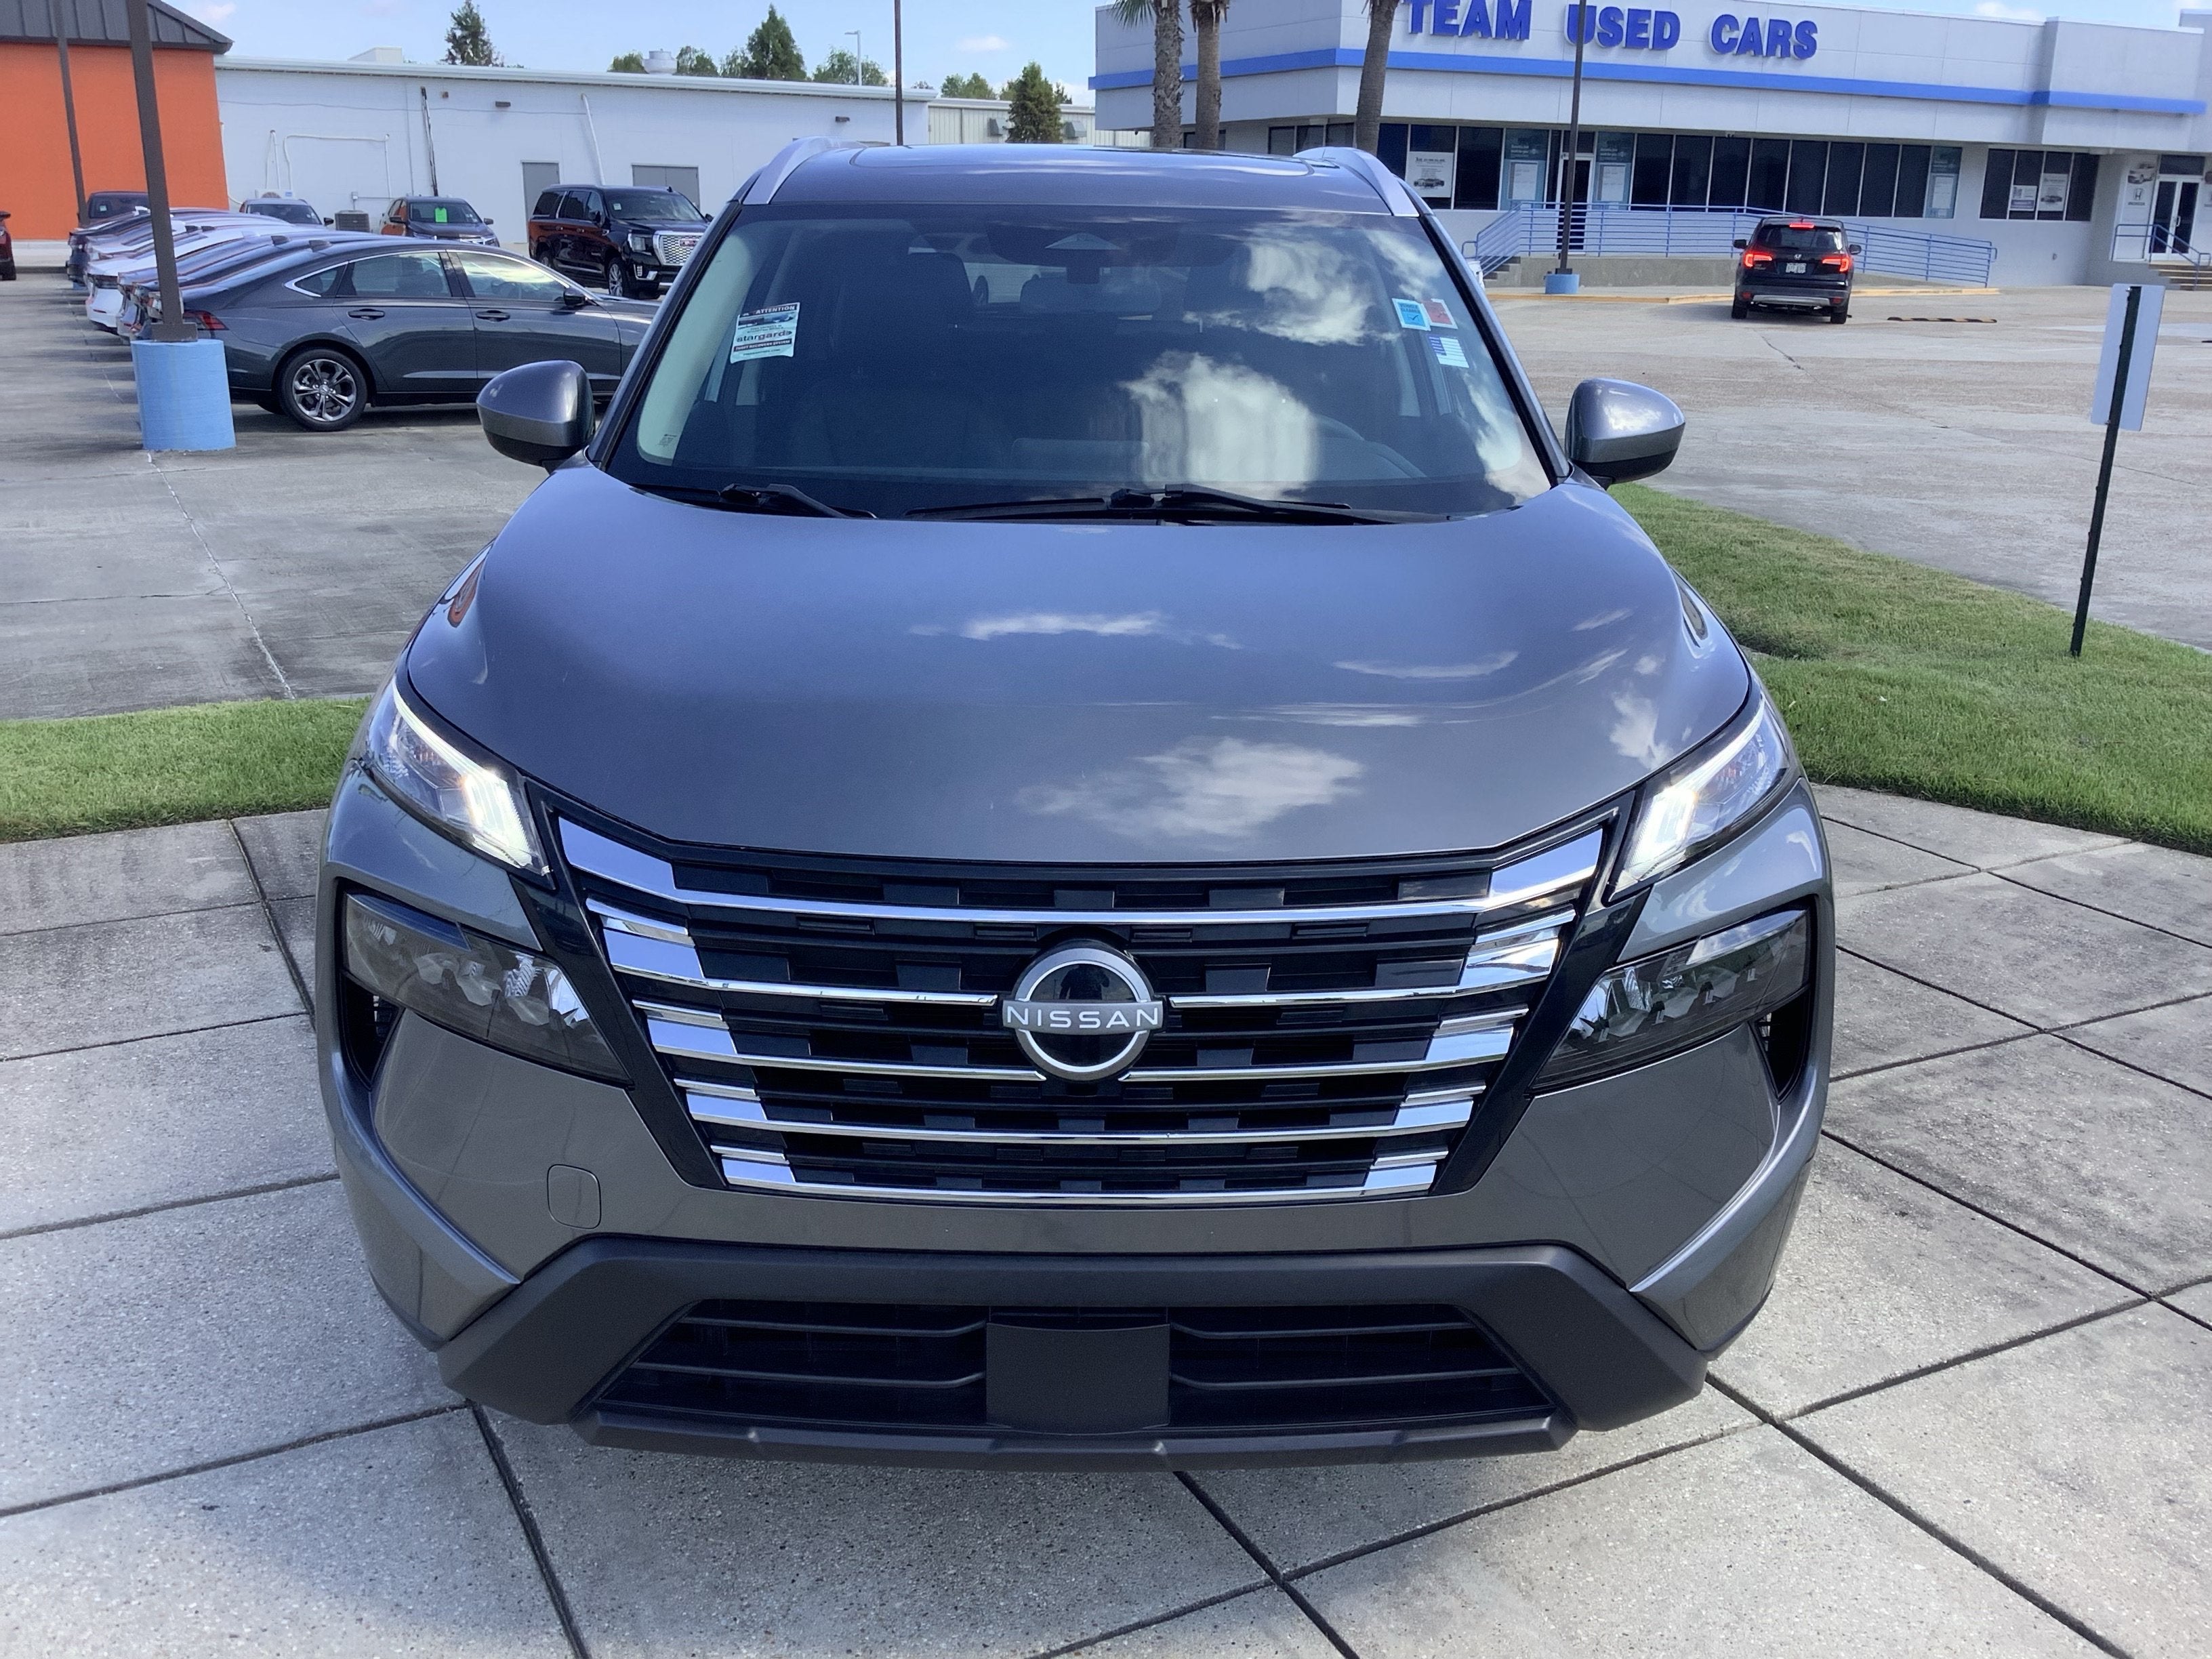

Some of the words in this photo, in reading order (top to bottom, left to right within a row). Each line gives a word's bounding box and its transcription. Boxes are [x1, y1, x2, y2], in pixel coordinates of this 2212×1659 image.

[1402, 0, 1532, 40] TEAM
[1564, 4, 1681, 50] USED
[1709, 14, 1818, 60] CARS
[756, 305, 795, 314] ATTENTION
[1006, 1006, 1158, 1029] NISSAN
